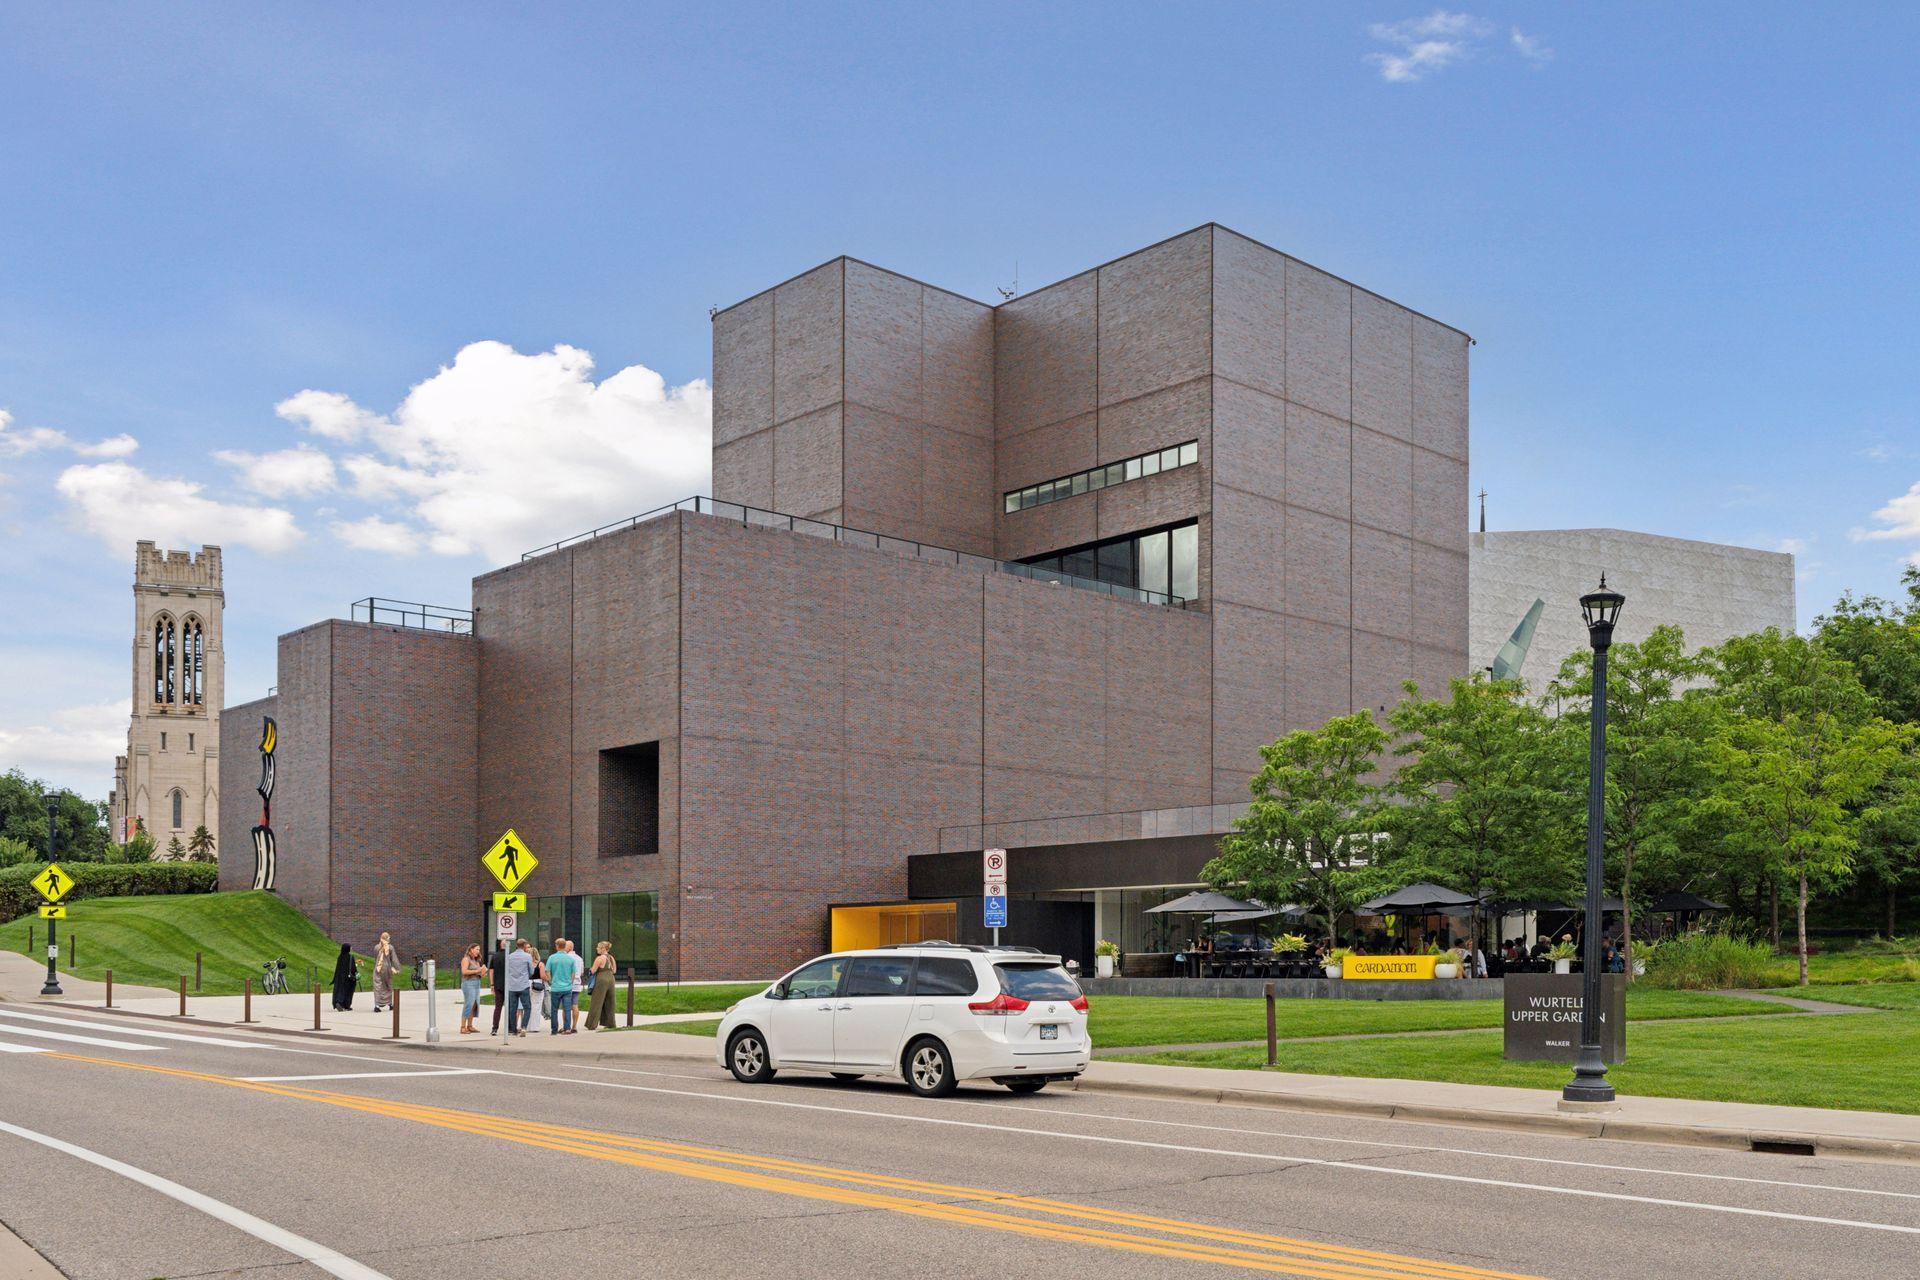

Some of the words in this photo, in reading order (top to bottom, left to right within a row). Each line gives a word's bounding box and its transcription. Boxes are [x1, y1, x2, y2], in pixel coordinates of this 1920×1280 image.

[1355, 962, 1417, 974] CARDAMOM
[1511, 1010, 1549, 1022] UPPER
[1552, 1011, 1606, 1023] GARN
